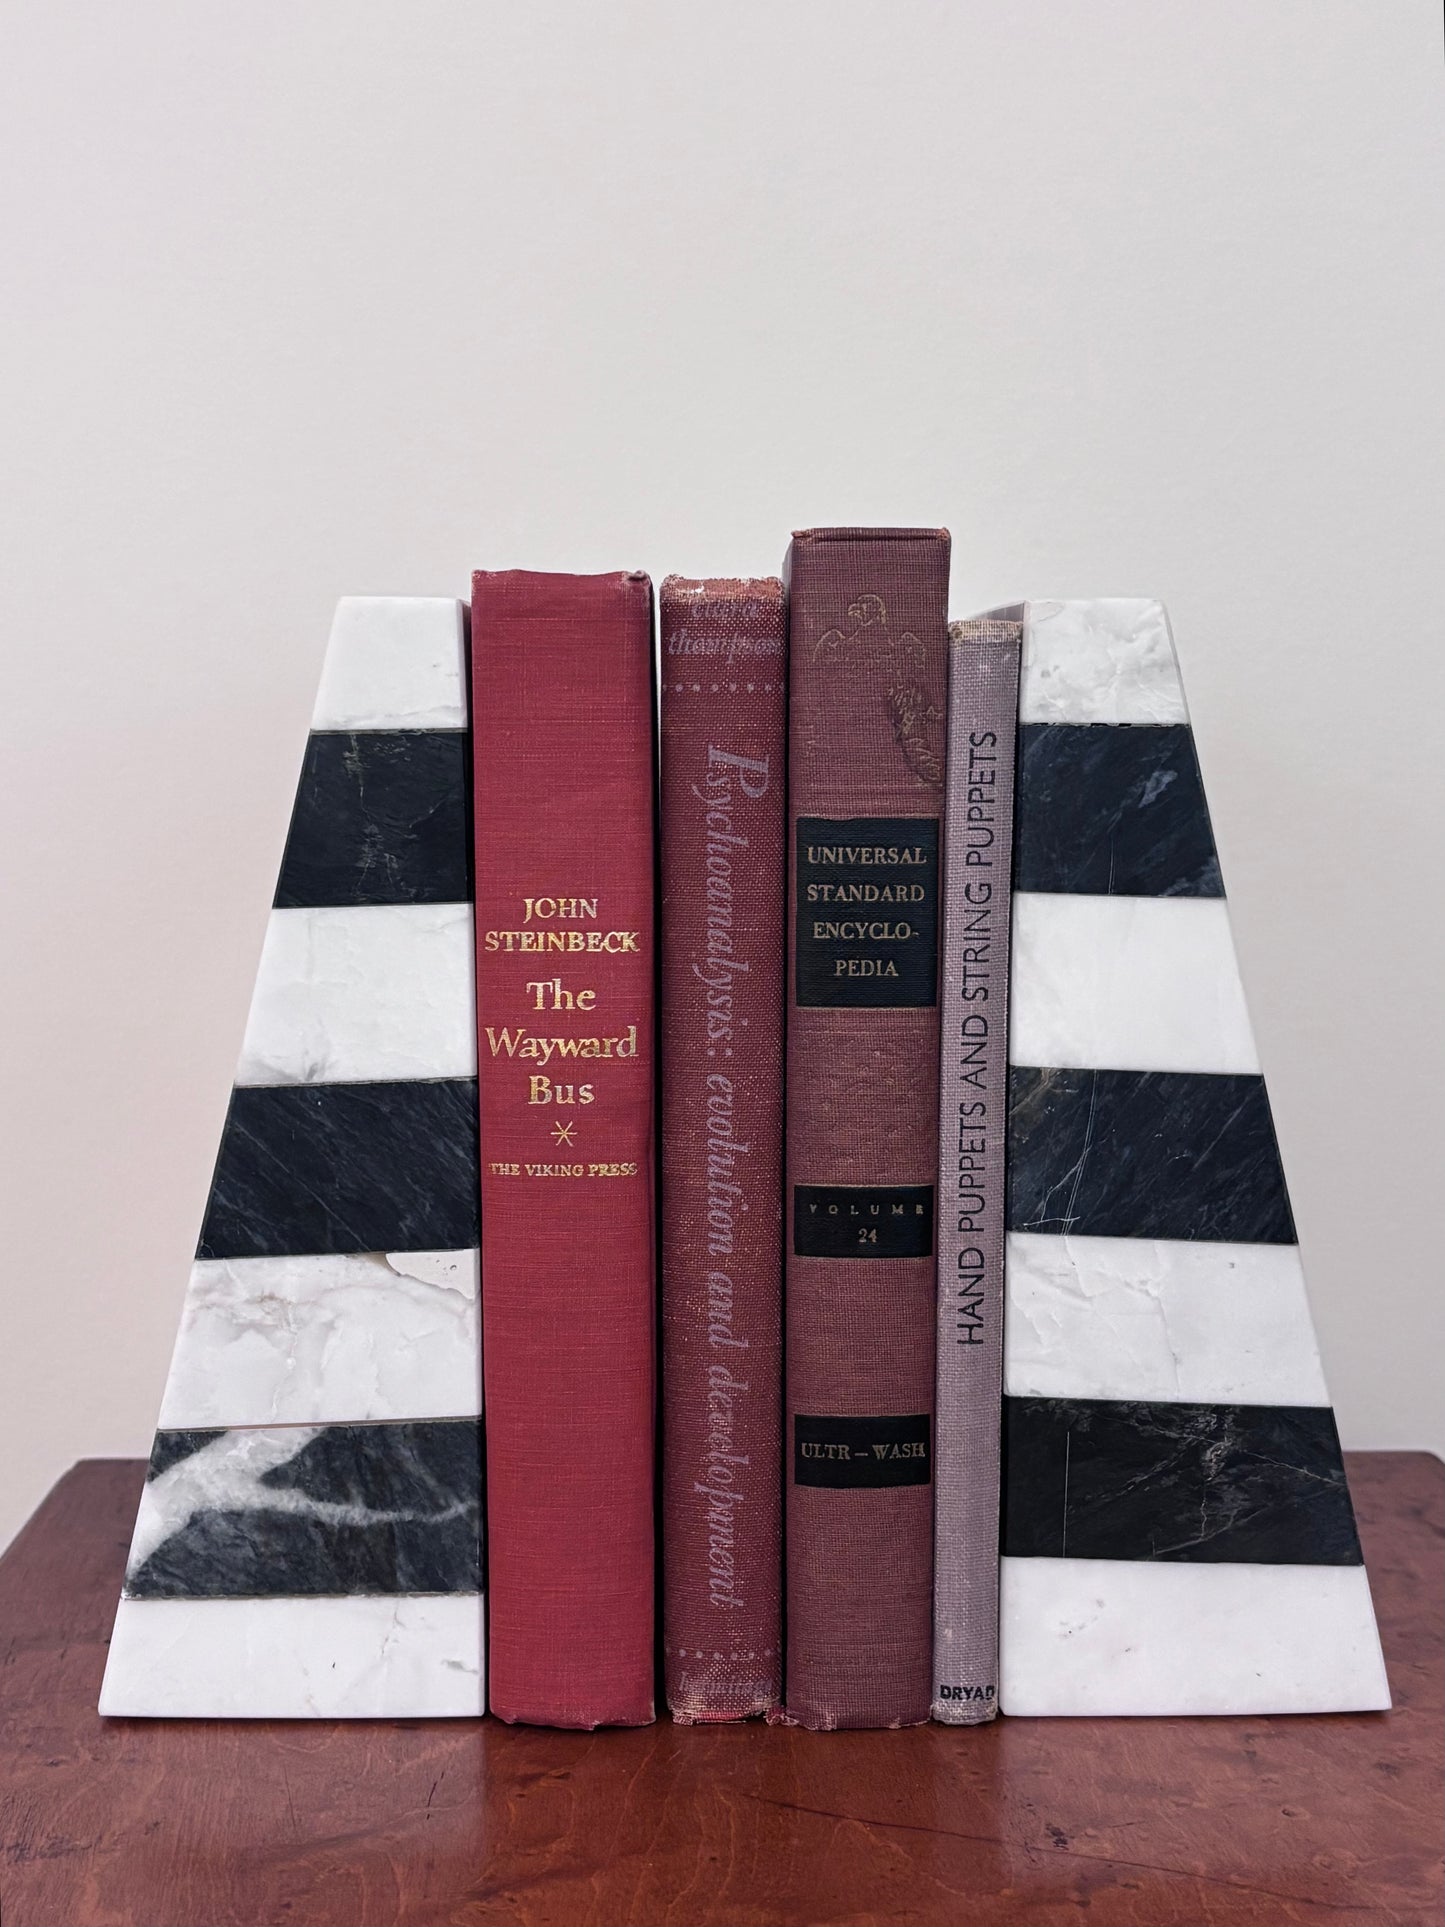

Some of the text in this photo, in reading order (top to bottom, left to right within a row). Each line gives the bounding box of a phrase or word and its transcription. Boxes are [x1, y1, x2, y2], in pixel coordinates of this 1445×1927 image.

[807, 846, 927, 864] UNIVERSAL
[807, 884, 925, 901] STANDARD
[523, 898, 598, 923] JOHN
[813, 922, 919, 939] ENCYCLO-
[485, 931, 640, 953] STEINBECK
[834, 960, 899, 976] PEDIA
[526, 979, 596, 1010] The
[485, 1026, 639, 1065] Wayward
[957, 732, 997, 1345] HAND PUPPETS AND STRING PUPPETS
[528, 1075, 595, 1105] Bus
[489, 1162, 638, 1176] THE VIKING PRESS
[692, 744, 769, 1606] Psychoanalysis: evolution and development
[809, 1204, 924, 1215] VOLUME
[858, 1228, 877, 1243] 24
[940, 1685, 995, 1700] DRYAD
